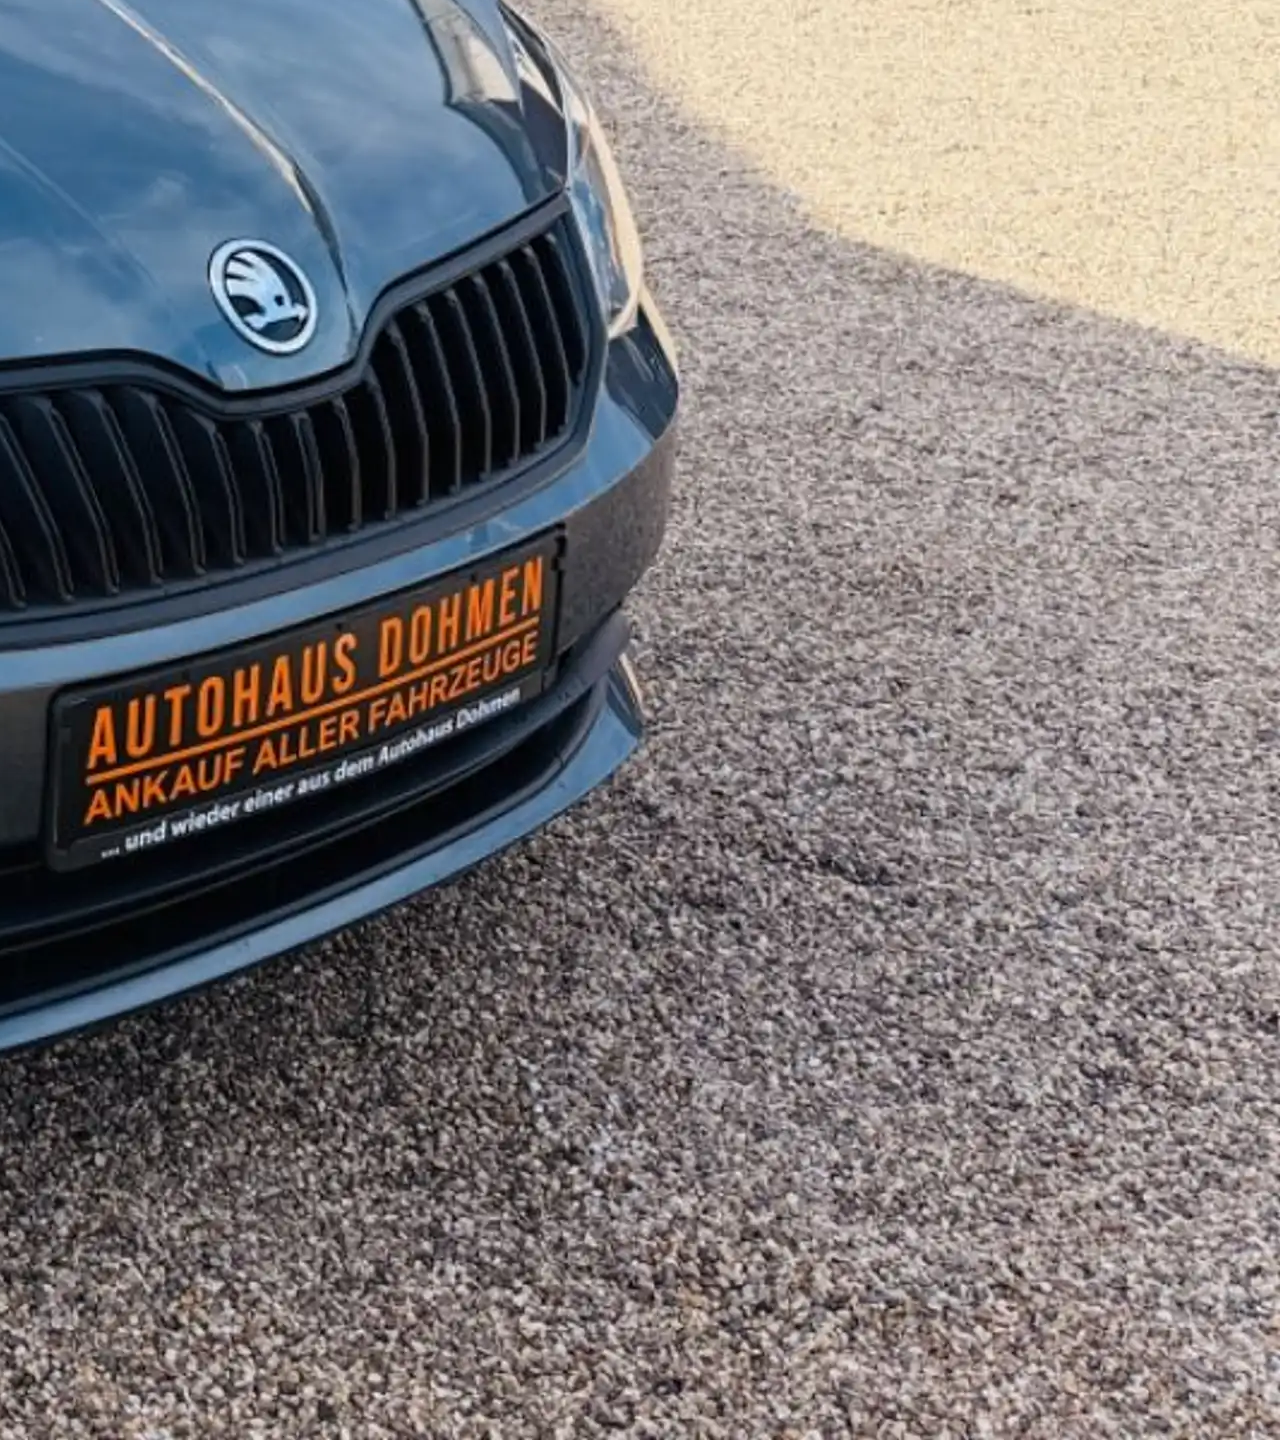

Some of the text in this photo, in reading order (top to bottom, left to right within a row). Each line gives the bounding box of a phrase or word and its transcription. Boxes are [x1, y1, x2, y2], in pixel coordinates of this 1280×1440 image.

[83, 630, 538, 826] ANKAUF ALLER FAHRZEUGE
[87, 556, 543, 769] AUTOHAUS DOHMEN
[125, 818, 167, 852] und
[171, 798, 241, 838] wieder
[243, 779, 295, 814] einer
[298, 769, 332, 795] aus
[334, 753, 375, 781] dem
[378, 719, 455, 767] Autohaus
[455, 685, 522, 730] Dohmen
